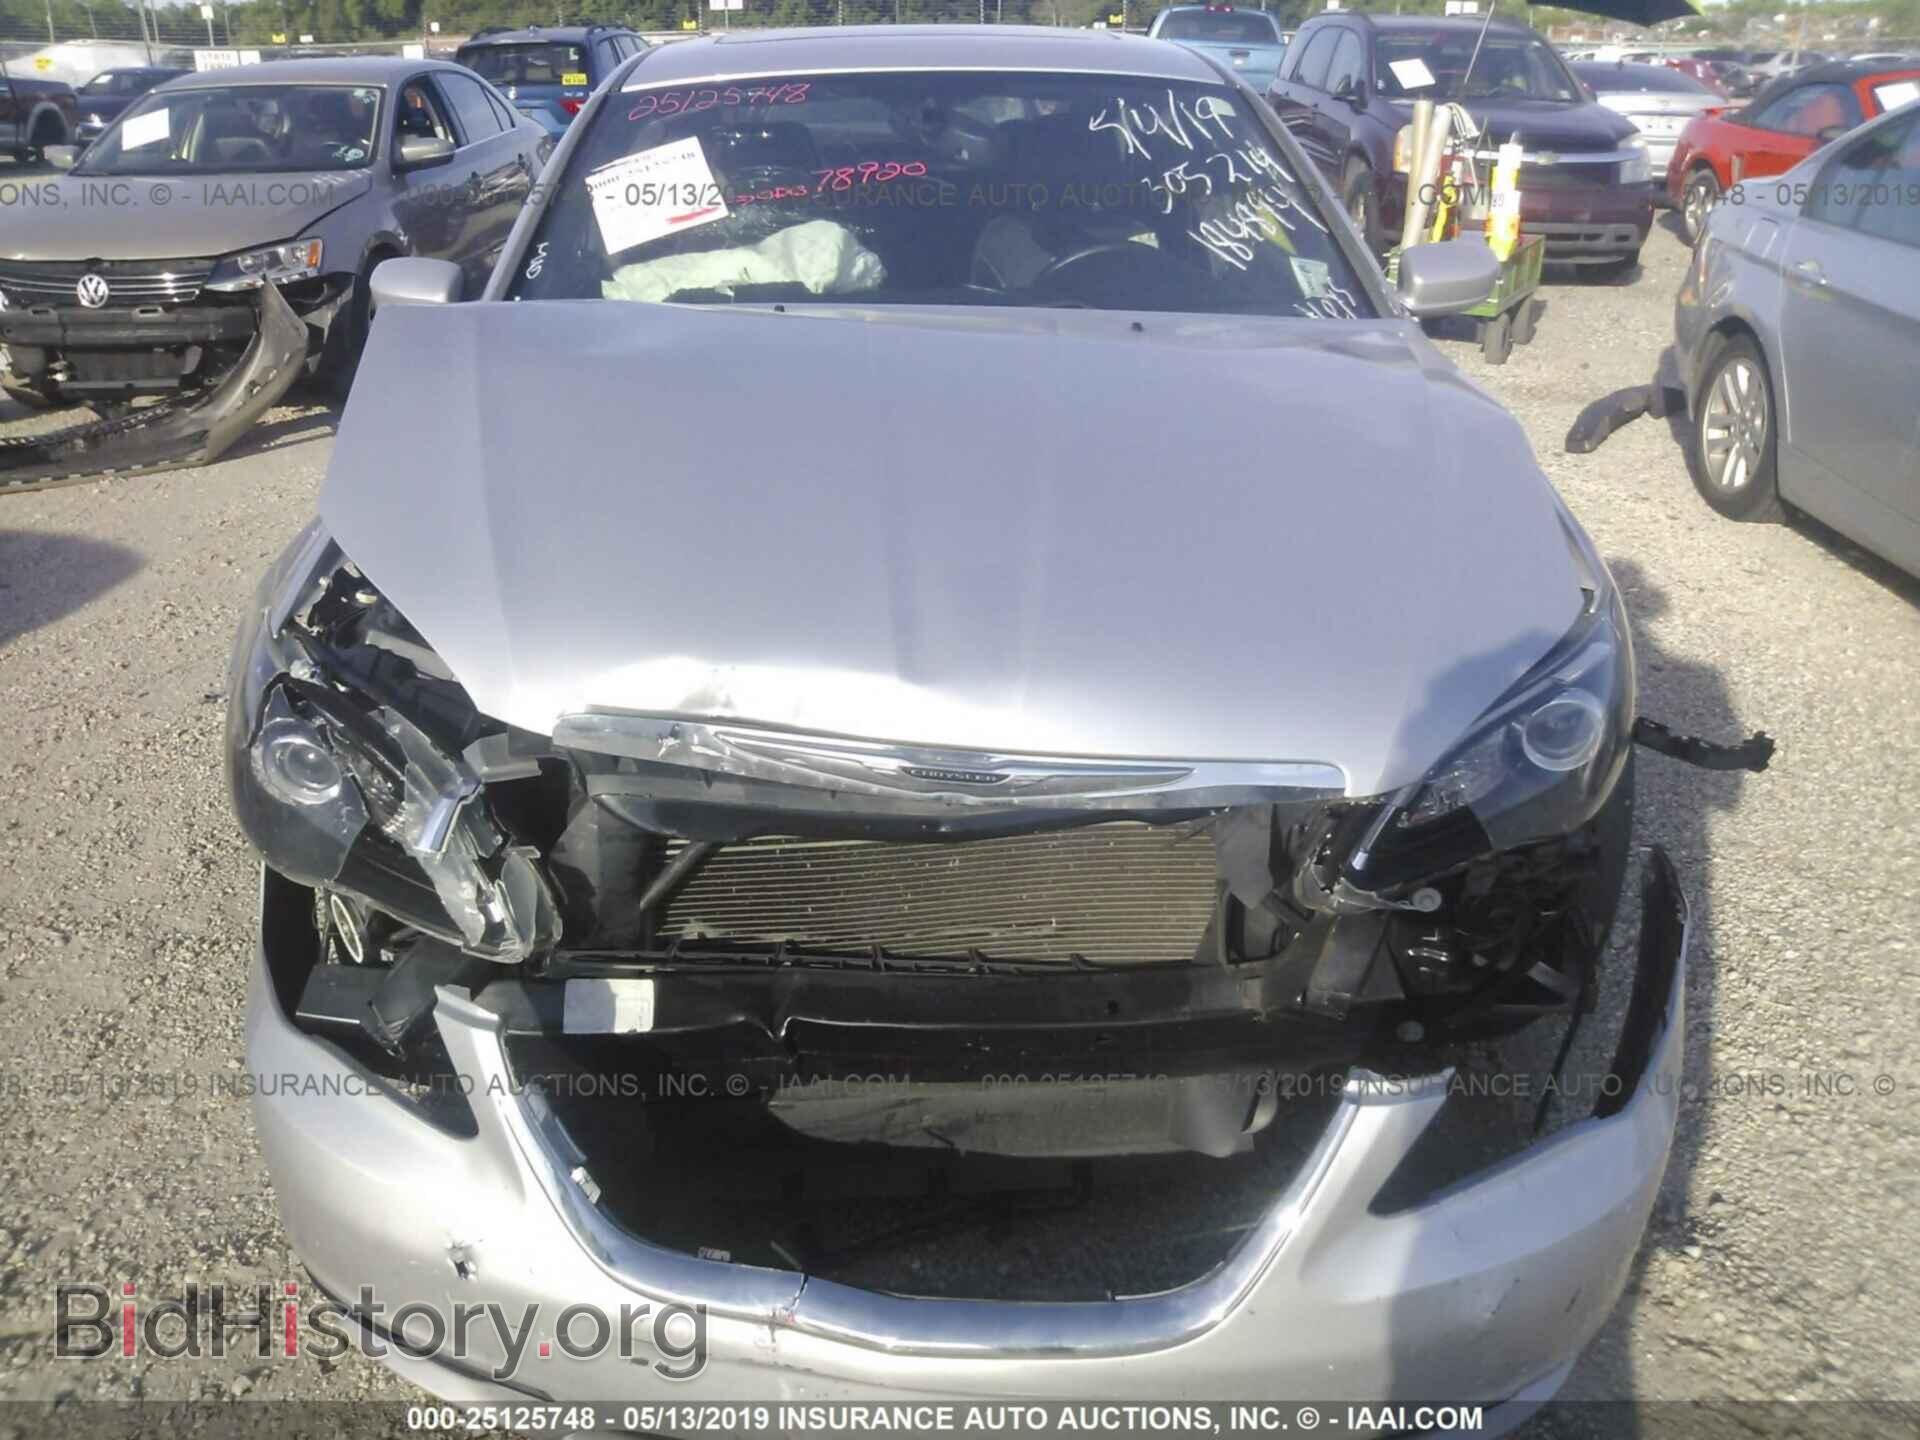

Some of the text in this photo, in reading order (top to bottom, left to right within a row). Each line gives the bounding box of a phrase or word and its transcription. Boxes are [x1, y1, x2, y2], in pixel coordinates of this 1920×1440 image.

[628, 83, 812, 121] 25125748
[814, 161, 928, 193] 78920
[910, 768, 998, 782] CHRYSLER
